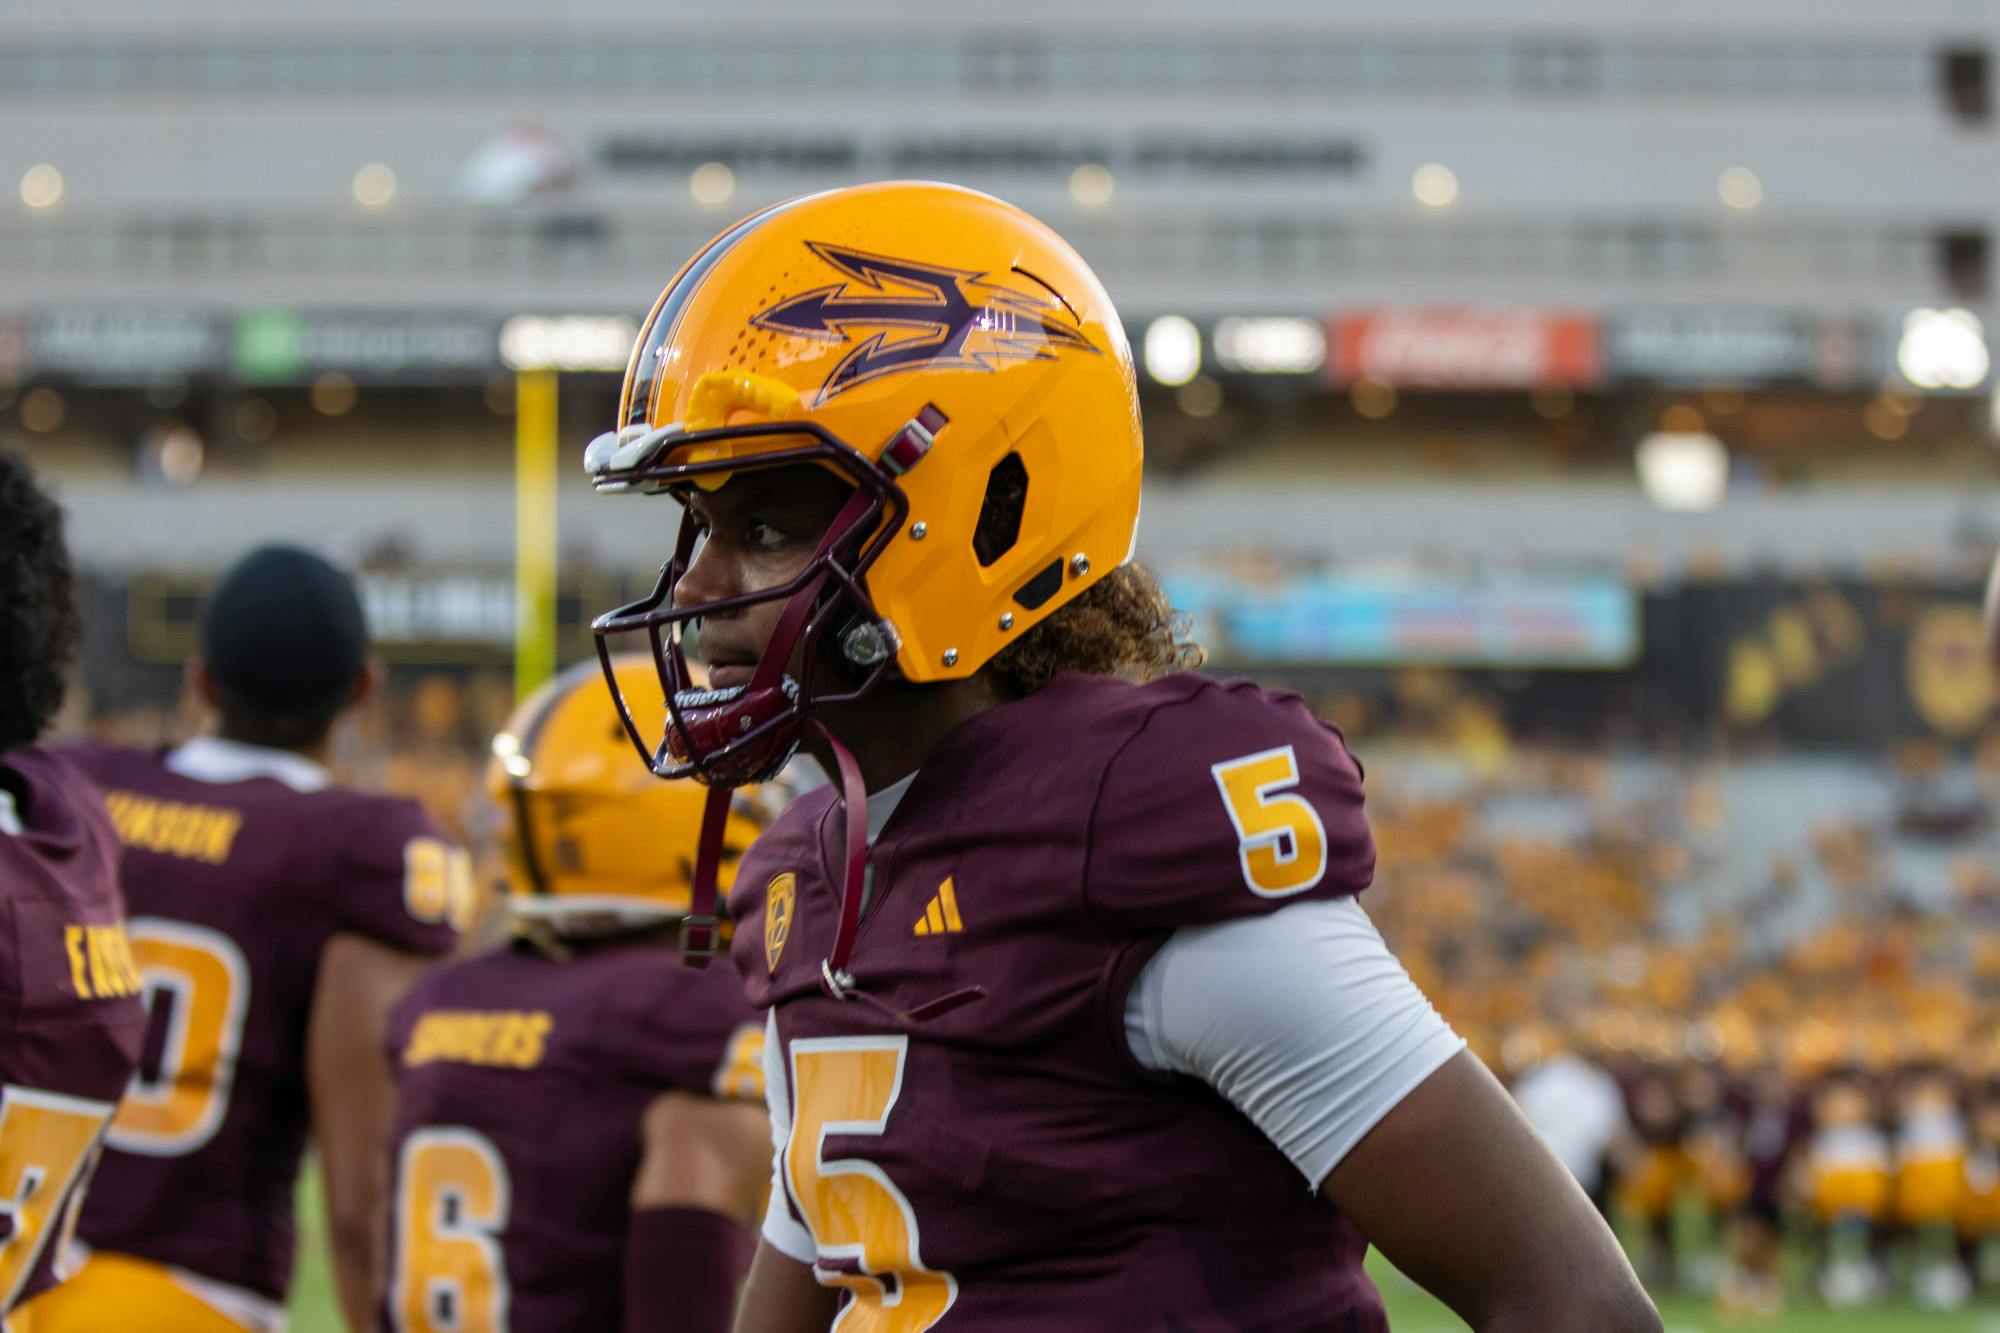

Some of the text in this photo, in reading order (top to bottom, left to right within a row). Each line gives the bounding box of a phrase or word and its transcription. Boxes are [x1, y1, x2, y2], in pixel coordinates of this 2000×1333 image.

[1211, 744, 1327, 898] 5
[390, 1125, 512, 1333] 6
[783, 1035, 958, 1333] 5
